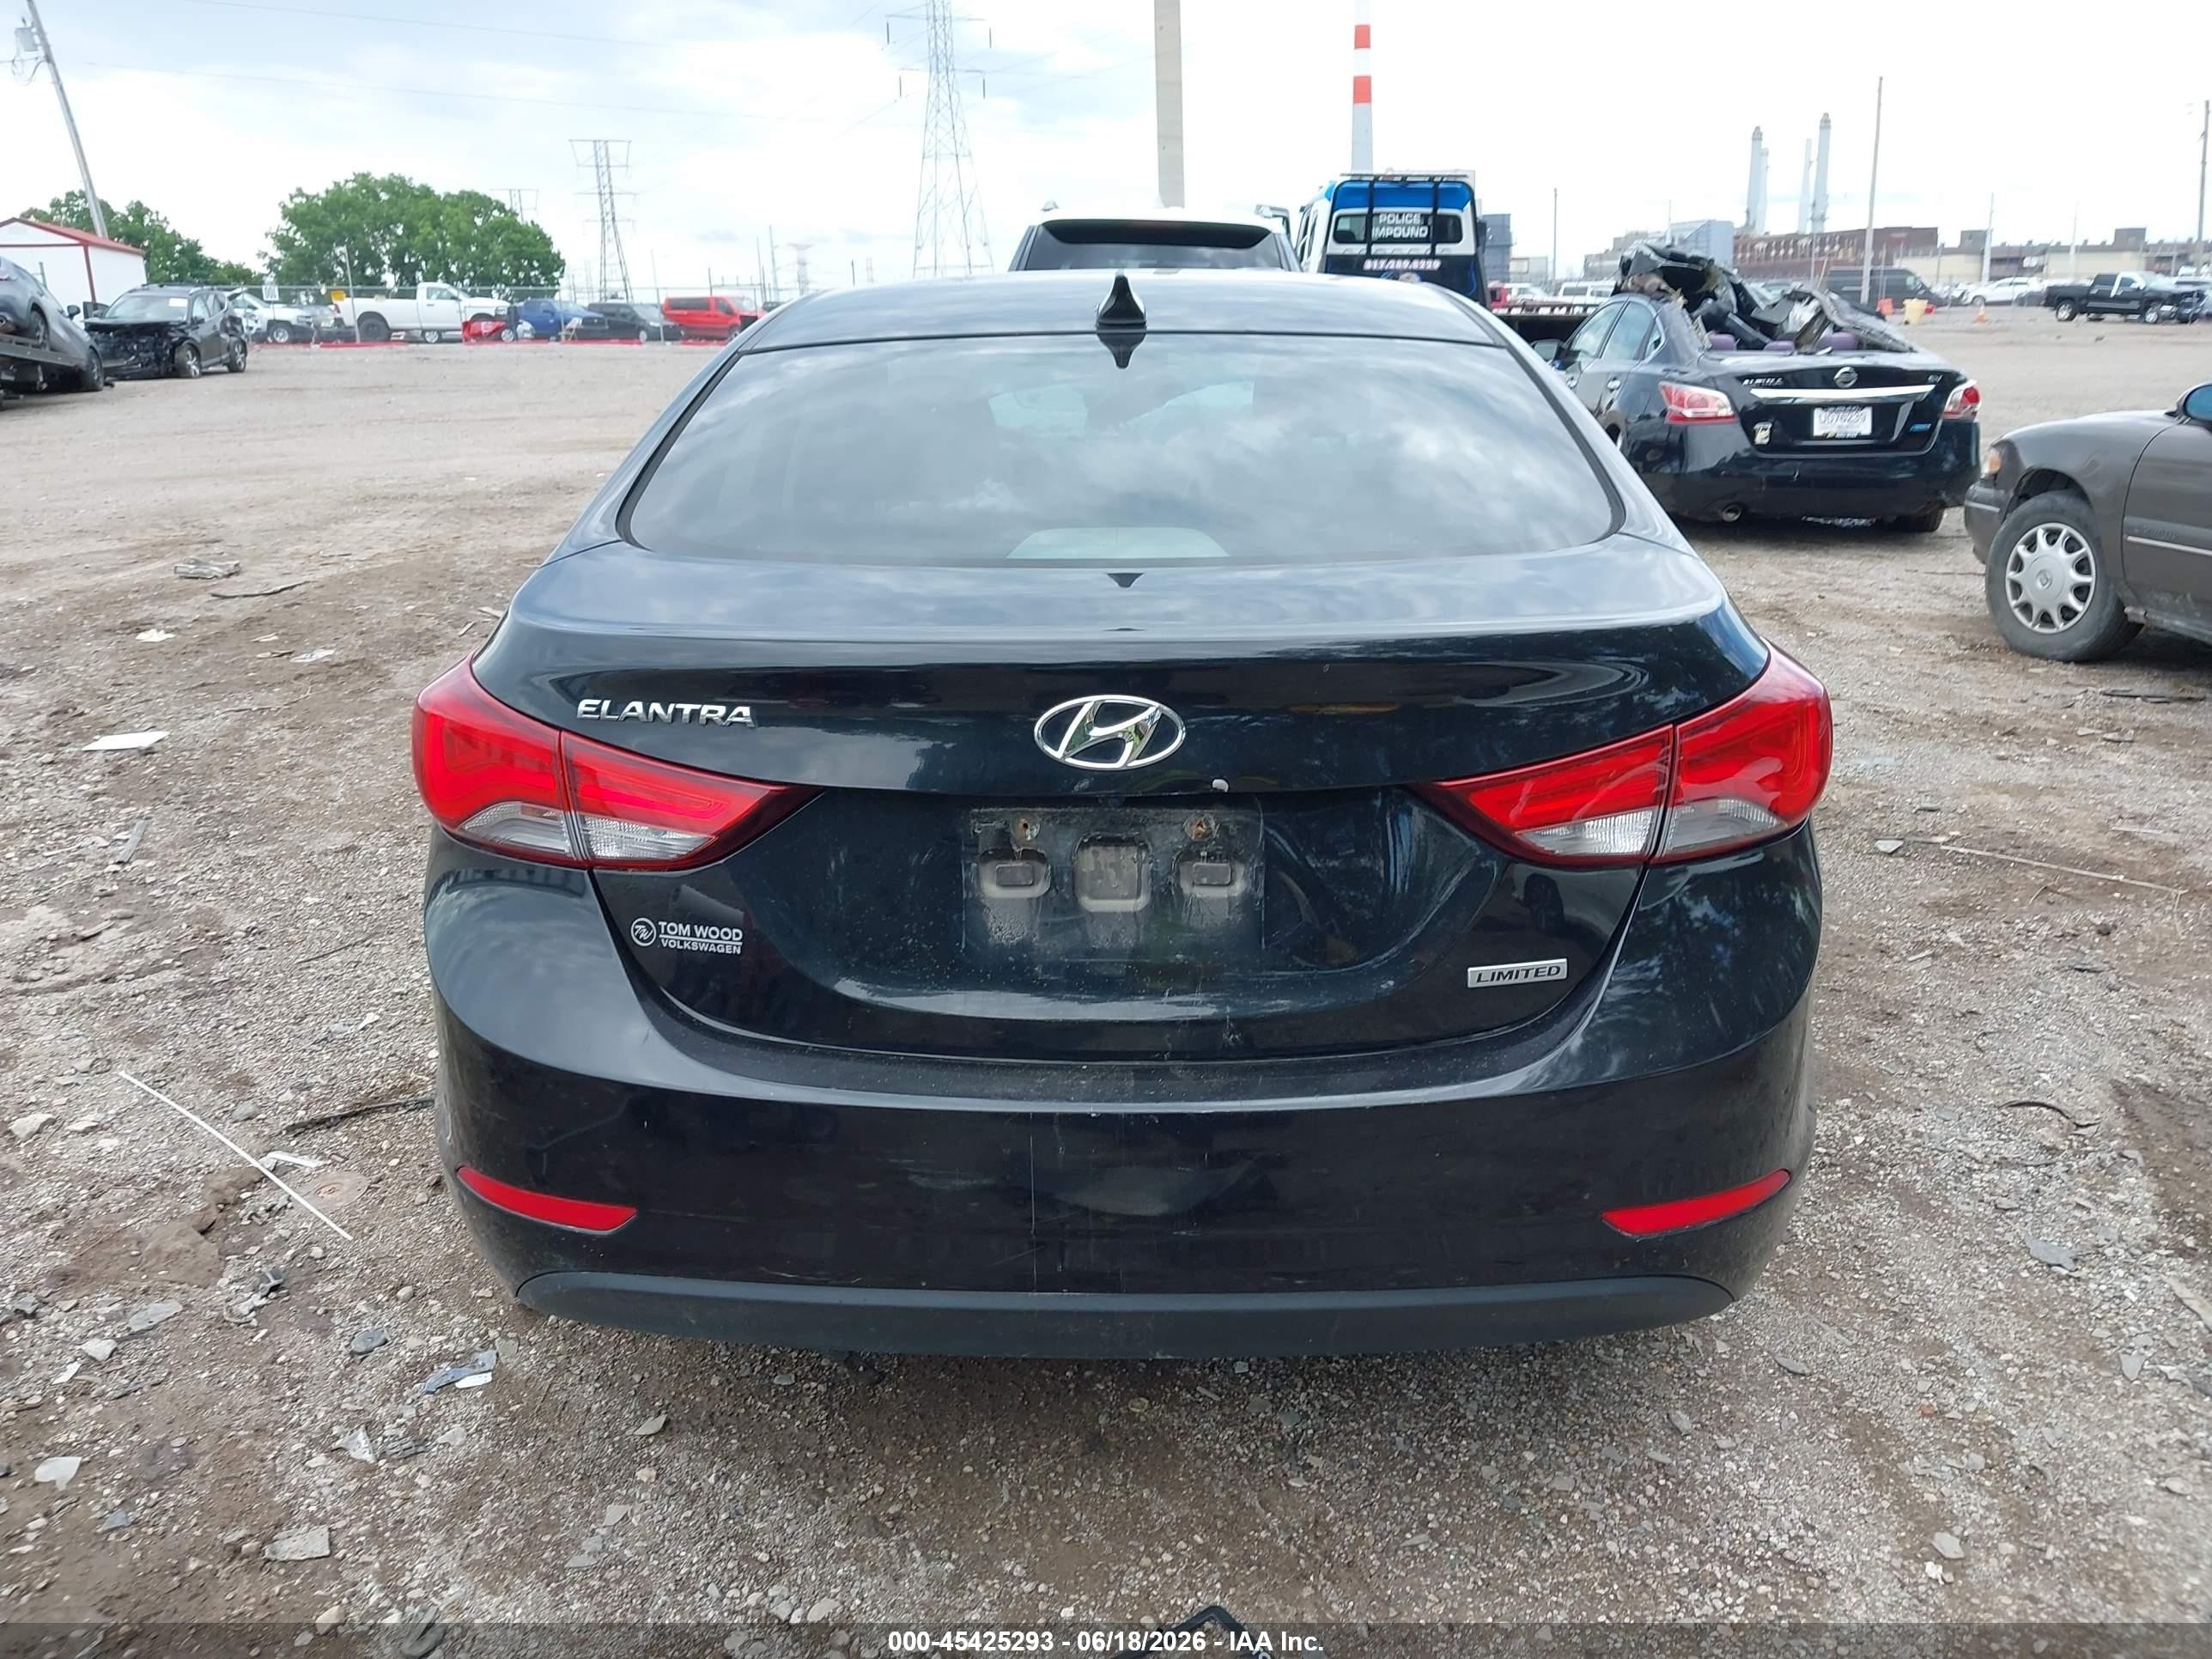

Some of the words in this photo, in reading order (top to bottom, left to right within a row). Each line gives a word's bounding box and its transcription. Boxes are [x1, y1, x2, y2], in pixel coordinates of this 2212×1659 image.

[1379, 213, 1421, 224] POLICE
[1372, 226, 1428, 238] IMPOUND
[577, 699, 756, 728] ELANTRA
[658, 921, 690, 937] TOM
[694, 925, 743, 941] WOOD
[661, 939, 741, 954] VOLKSWAGEN
[1477, 966, 1561, 983] LIMITED
